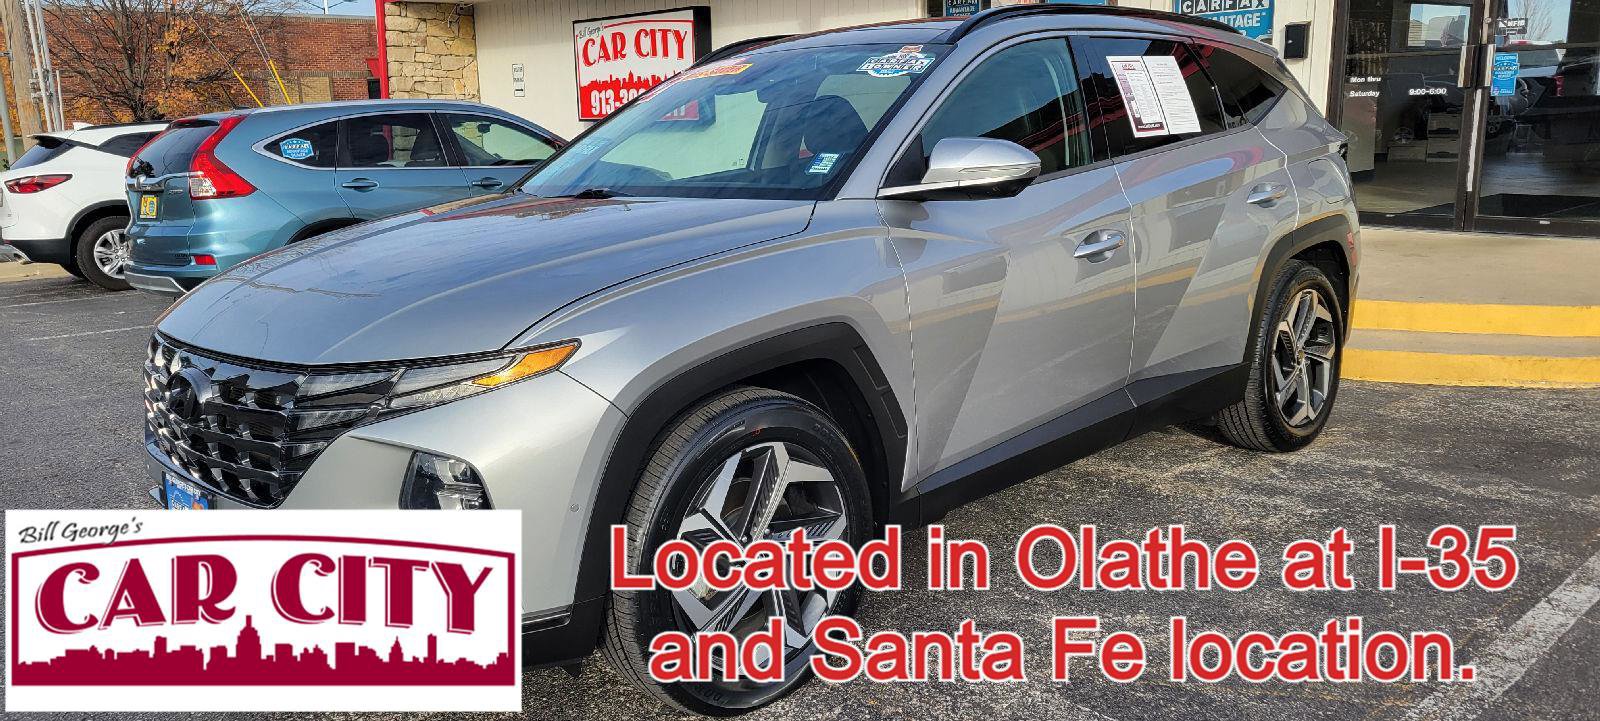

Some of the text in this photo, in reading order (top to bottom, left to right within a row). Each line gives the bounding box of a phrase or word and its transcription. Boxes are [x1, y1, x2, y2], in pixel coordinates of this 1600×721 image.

[1182, 0, 1269, 13] CARFAX
[582, 28, 688, 67] CAR CITY
